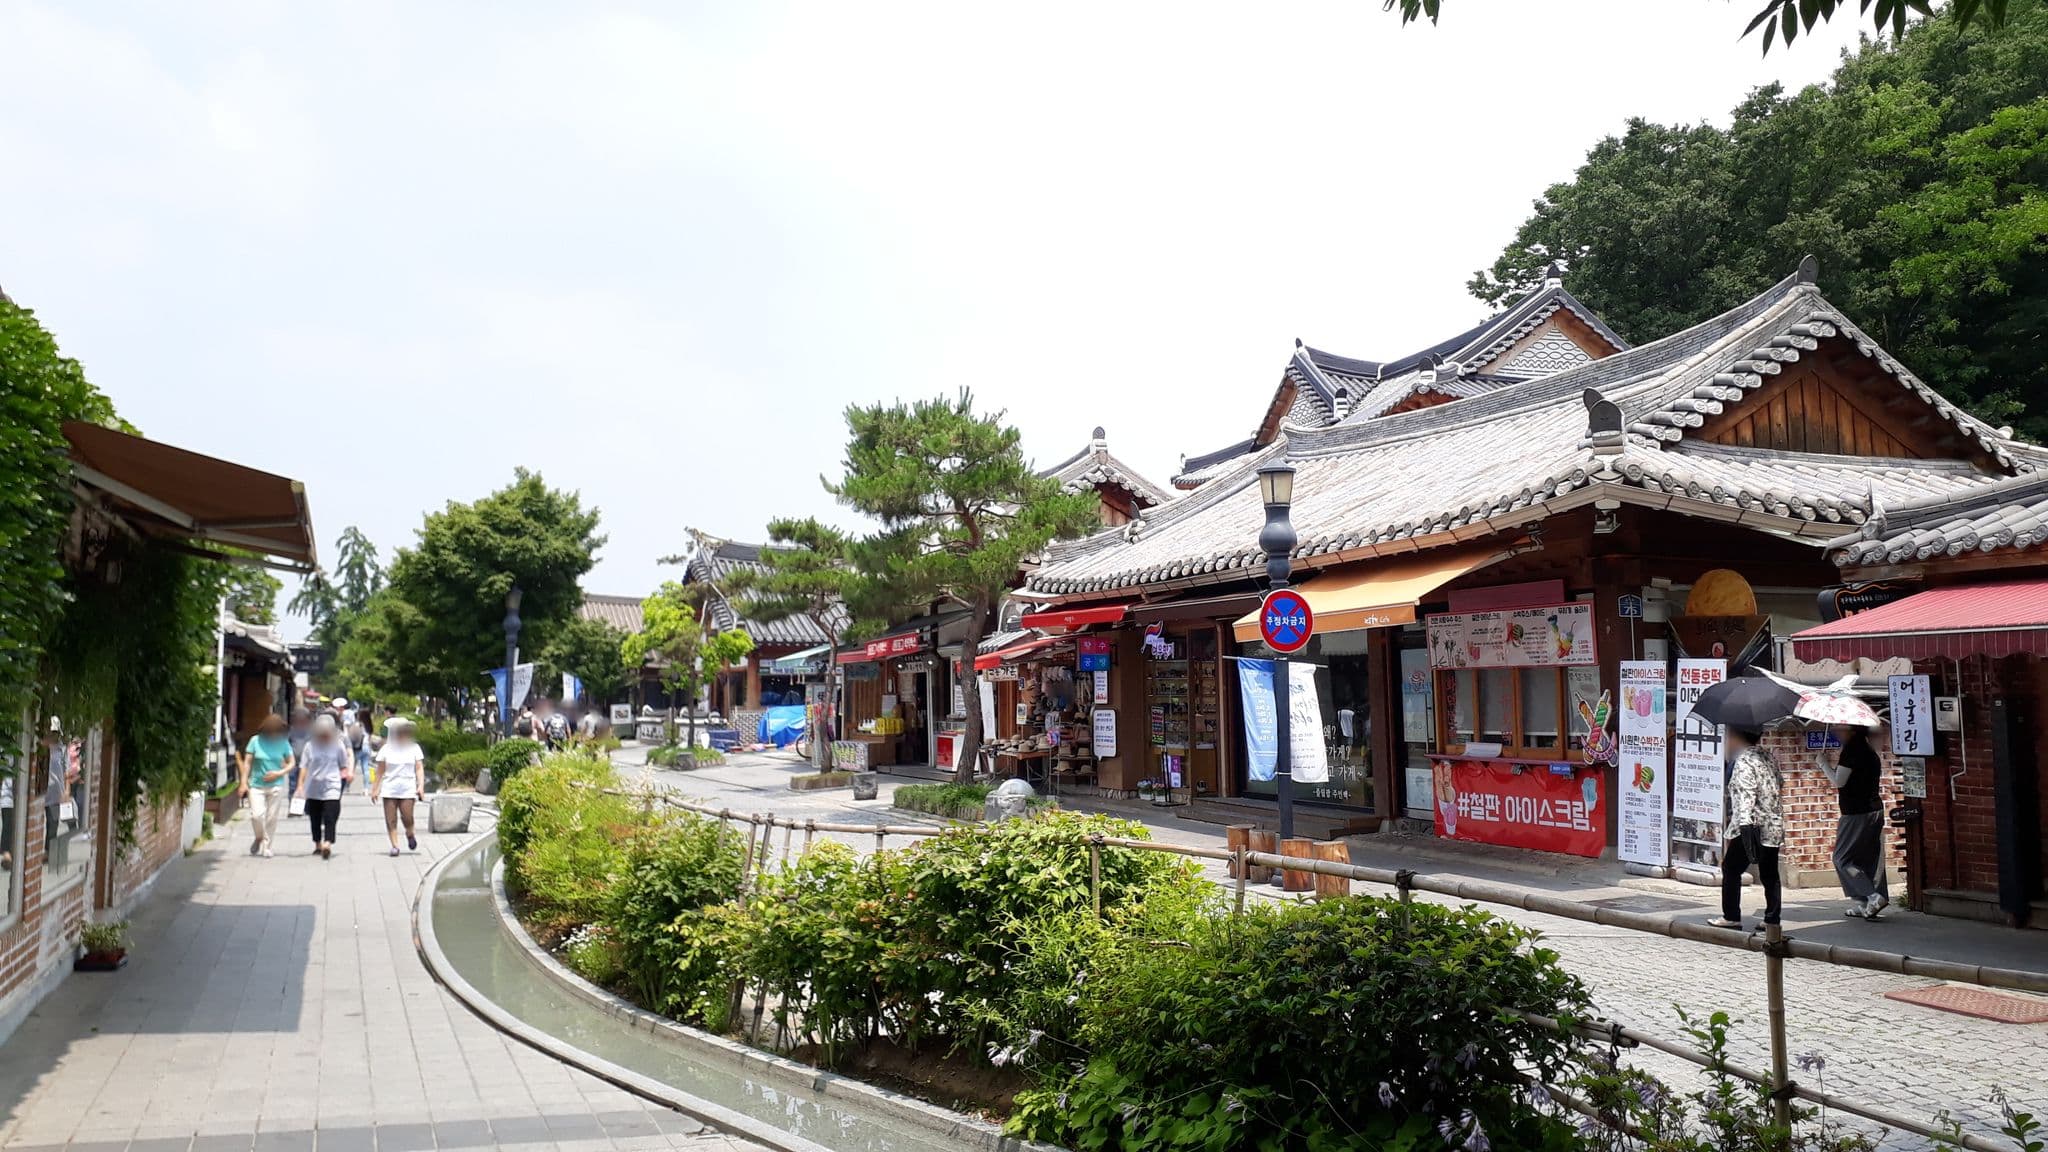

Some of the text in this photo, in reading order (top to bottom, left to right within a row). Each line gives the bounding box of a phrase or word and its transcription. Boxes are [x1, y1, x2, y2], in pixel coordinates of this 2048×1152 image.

[1266, 615, 1306, 627] 주정차금지
[1621, 668, 1666, 680] 철판아이스크림
[1680, 668, 1721, 685] 전동호떡
[1900, 678, 1918, 752] 어울림
[1620, 734, 1665, 748] 시원한 수박쥬스
[1325, 744, 1351, 761] 가게?
[1457, 792, 1501, 822] #철판
